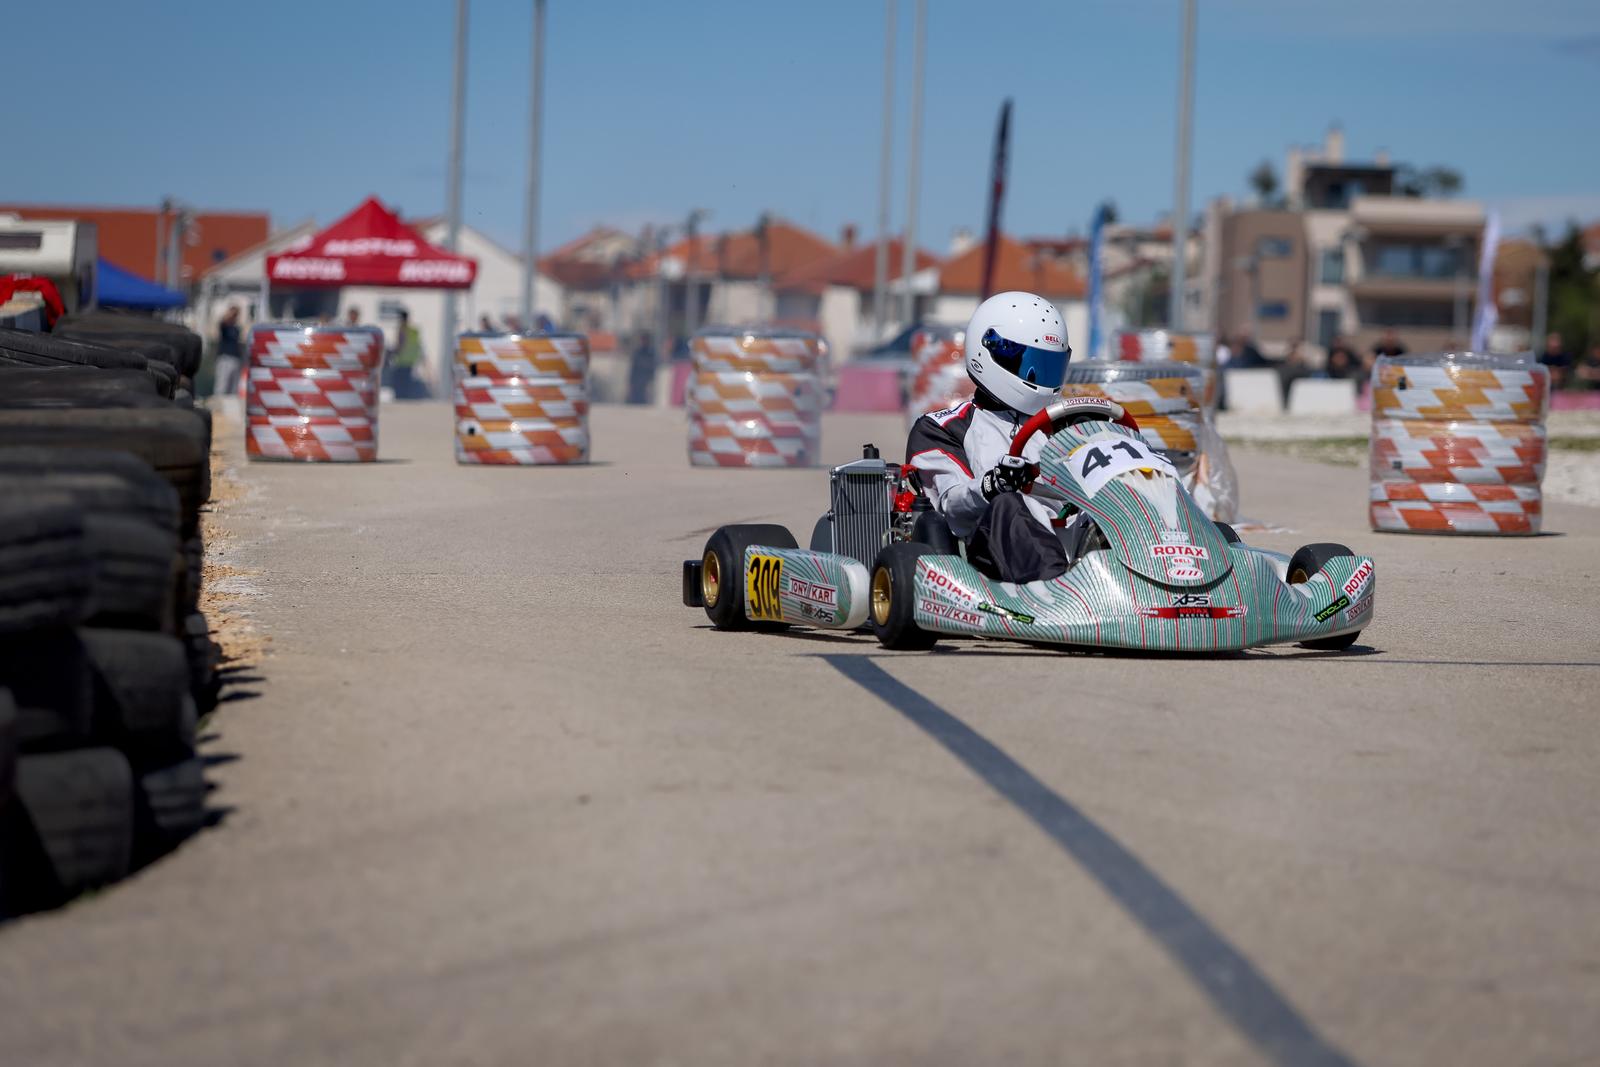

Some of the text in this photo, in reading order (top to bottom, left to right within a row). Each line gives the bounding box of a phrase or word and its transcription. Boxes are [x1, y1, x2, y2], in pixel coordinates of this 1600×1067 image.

[1045, 335, 1060, 343] BELL
[1154, 546, 1204, 557] ROTAX
[750, 557, 781, 618] 309
[926, 569, 975, 601] ROTAX
[1345, 562, 1372, 596] ROTAX
[811, 585, 835, 605] KART
[922, 600, 949, 617] TONY
[953, 608, 983, 625] KART
